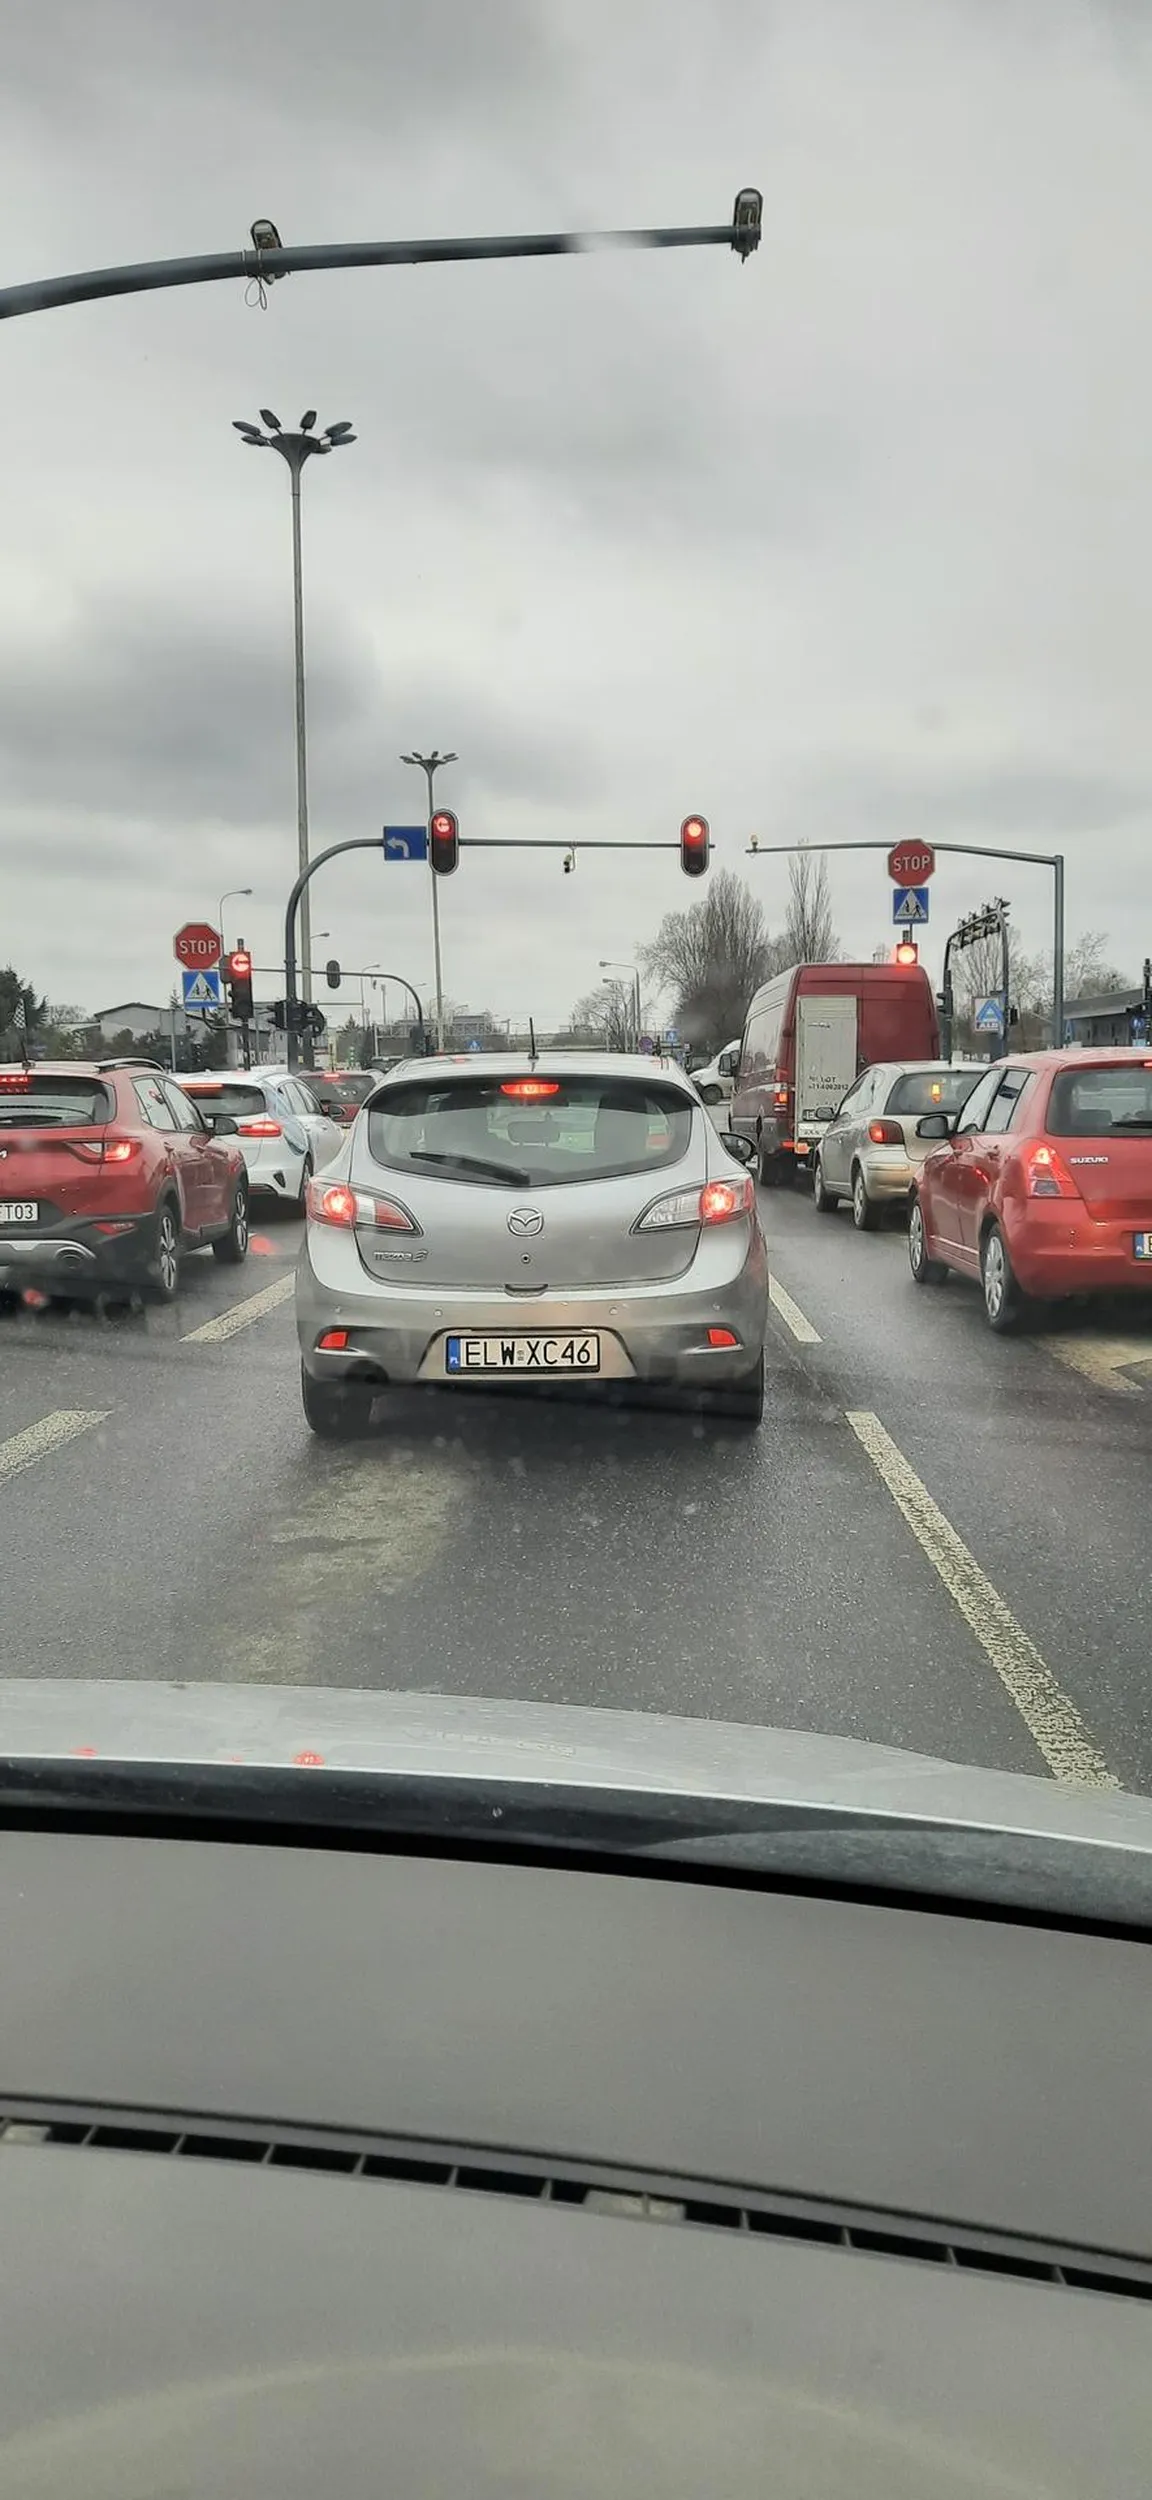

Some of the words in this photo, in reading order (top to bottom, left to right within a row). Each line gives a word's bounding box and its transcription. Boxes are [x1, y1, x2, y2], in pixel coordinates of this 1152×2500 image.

[893, 855, 931, 872] STOP
[179, 940, 217, 954] STOP
[1070, 1156, 1109, 1164] SUZUKI
[0, 1204, 34, 1220] T03
